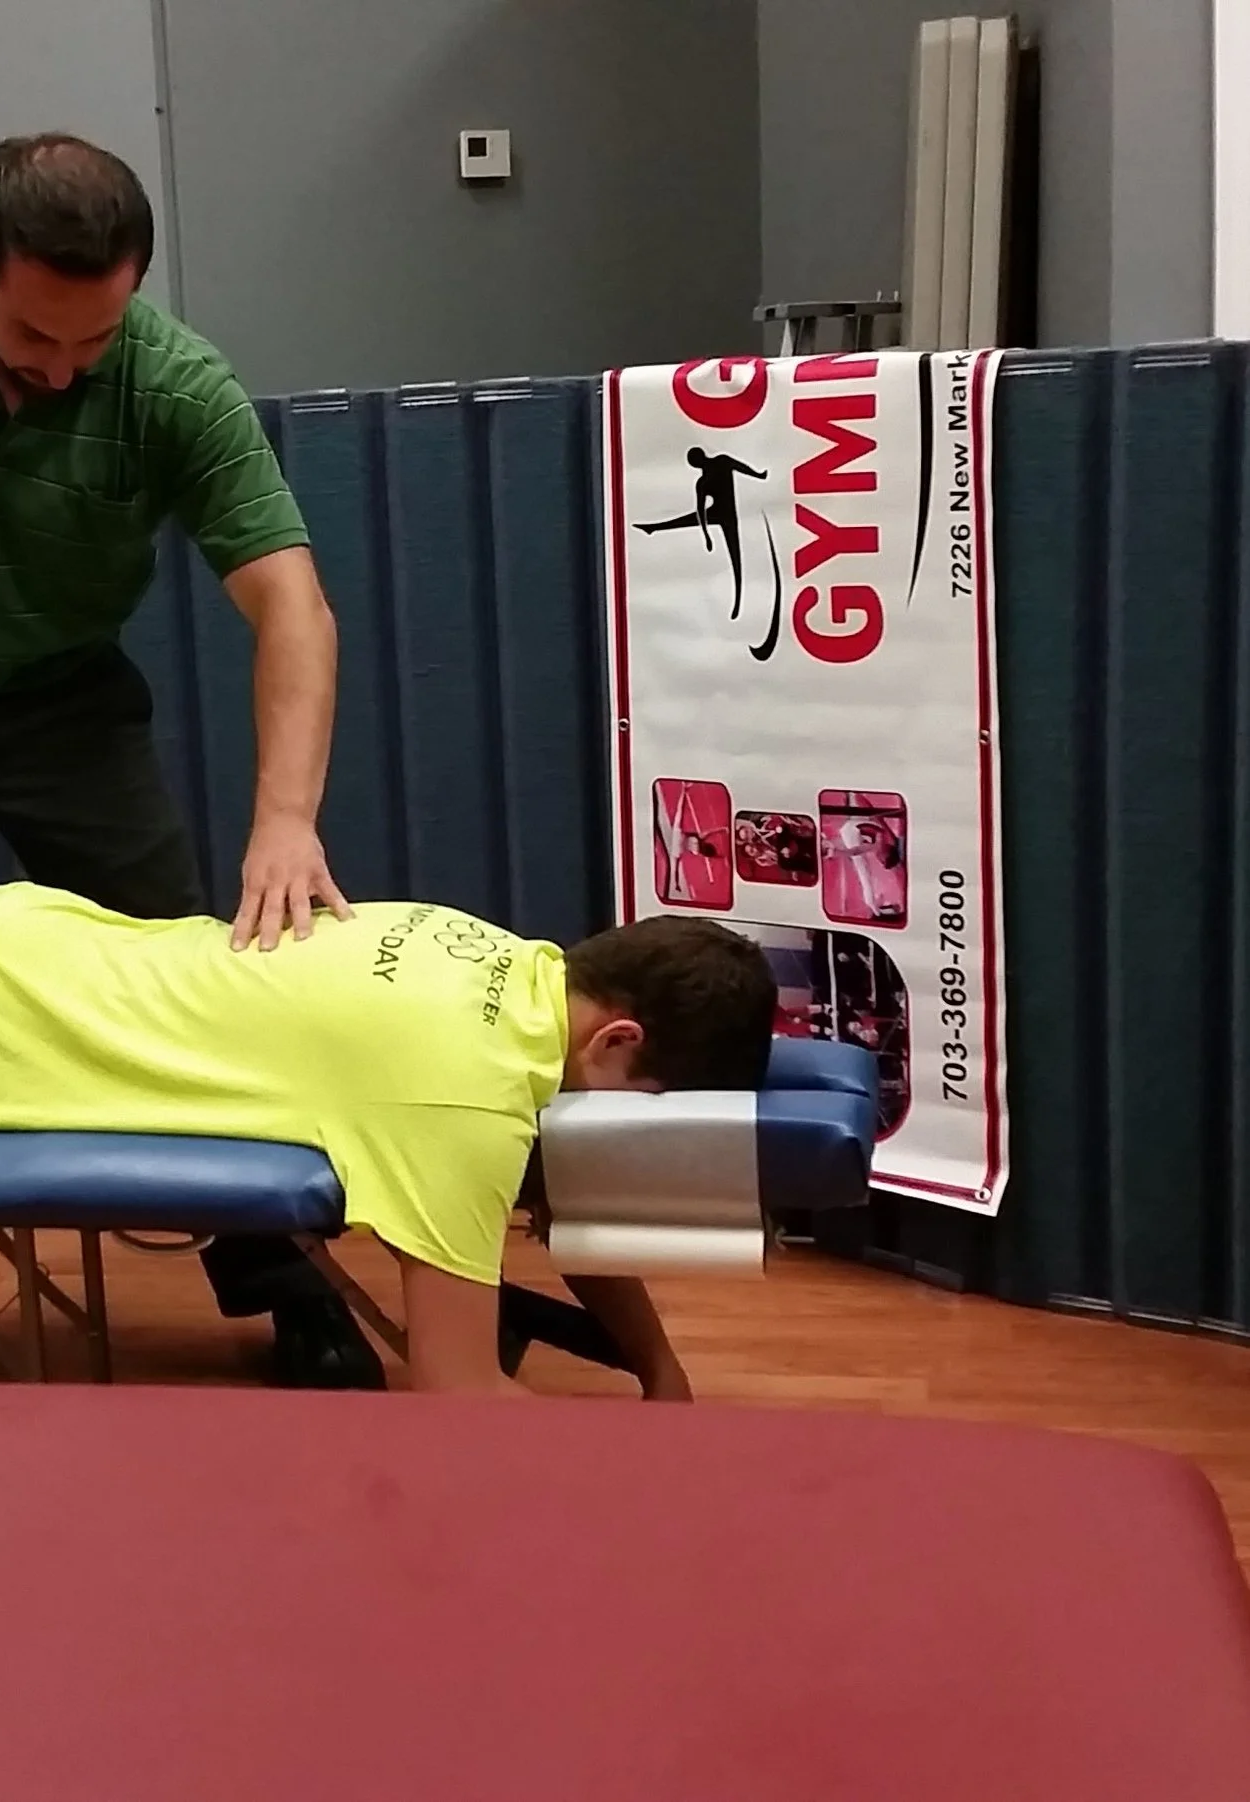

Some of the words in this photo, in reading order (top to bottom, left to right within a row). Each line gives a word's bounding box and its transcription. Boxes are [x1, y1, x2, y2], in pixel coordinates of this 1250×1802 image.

[949, 443, 971, 512] New
[951, 524, 972, 598] 7226
[372, 936, 405, 983] DAY
[483, 956, 513, 1026] DISCOER
[939, 870, 968, 1102] 703-369-7800
